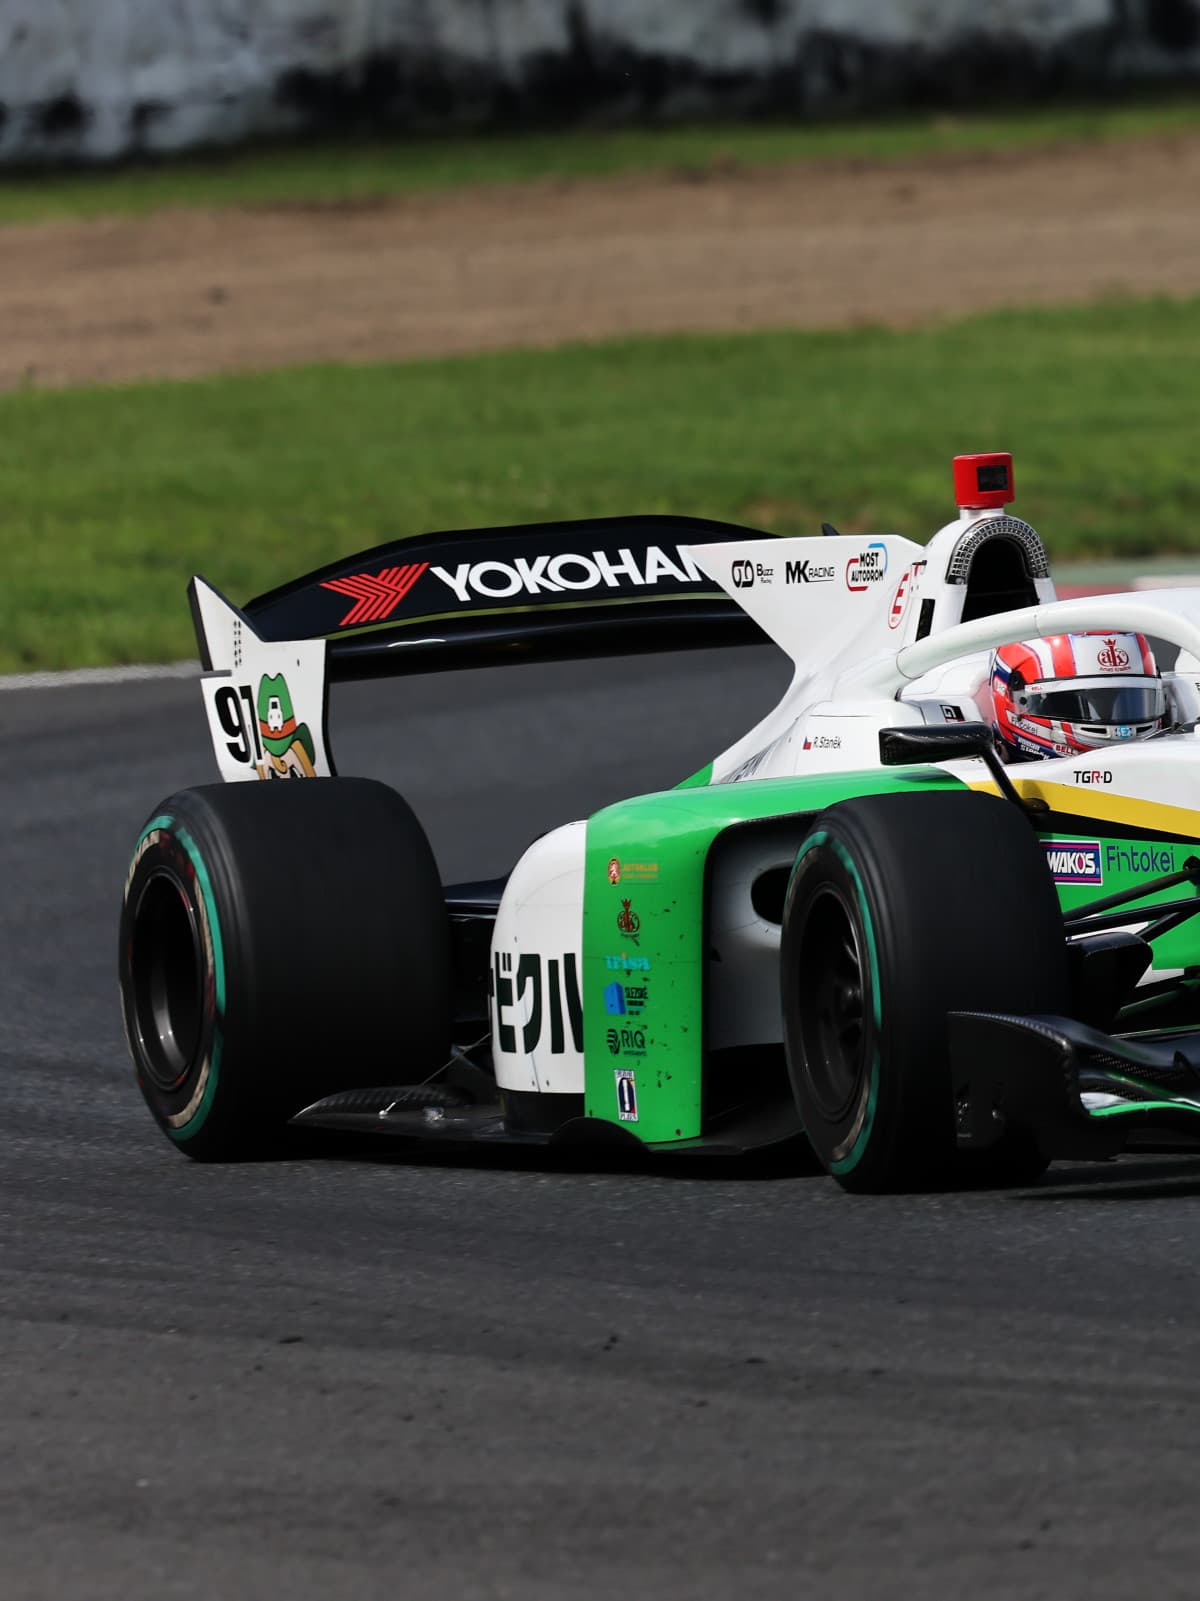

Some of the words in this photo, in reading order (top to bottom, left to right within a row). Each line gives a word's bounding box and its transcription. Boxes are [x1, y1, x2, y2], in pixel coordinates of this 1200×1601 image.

[757, 564, 774, 577] Buzz
[859, 553, 879, 568] MOST
[851, 569, 884, 583] AUTODROM
[214, 685, 263, 764] 97
[1106, 845, 1175, 873] Fintokei
[490, 952, 585, 1054] ビクル
[621, 1029, 646, 1049] RIQ
